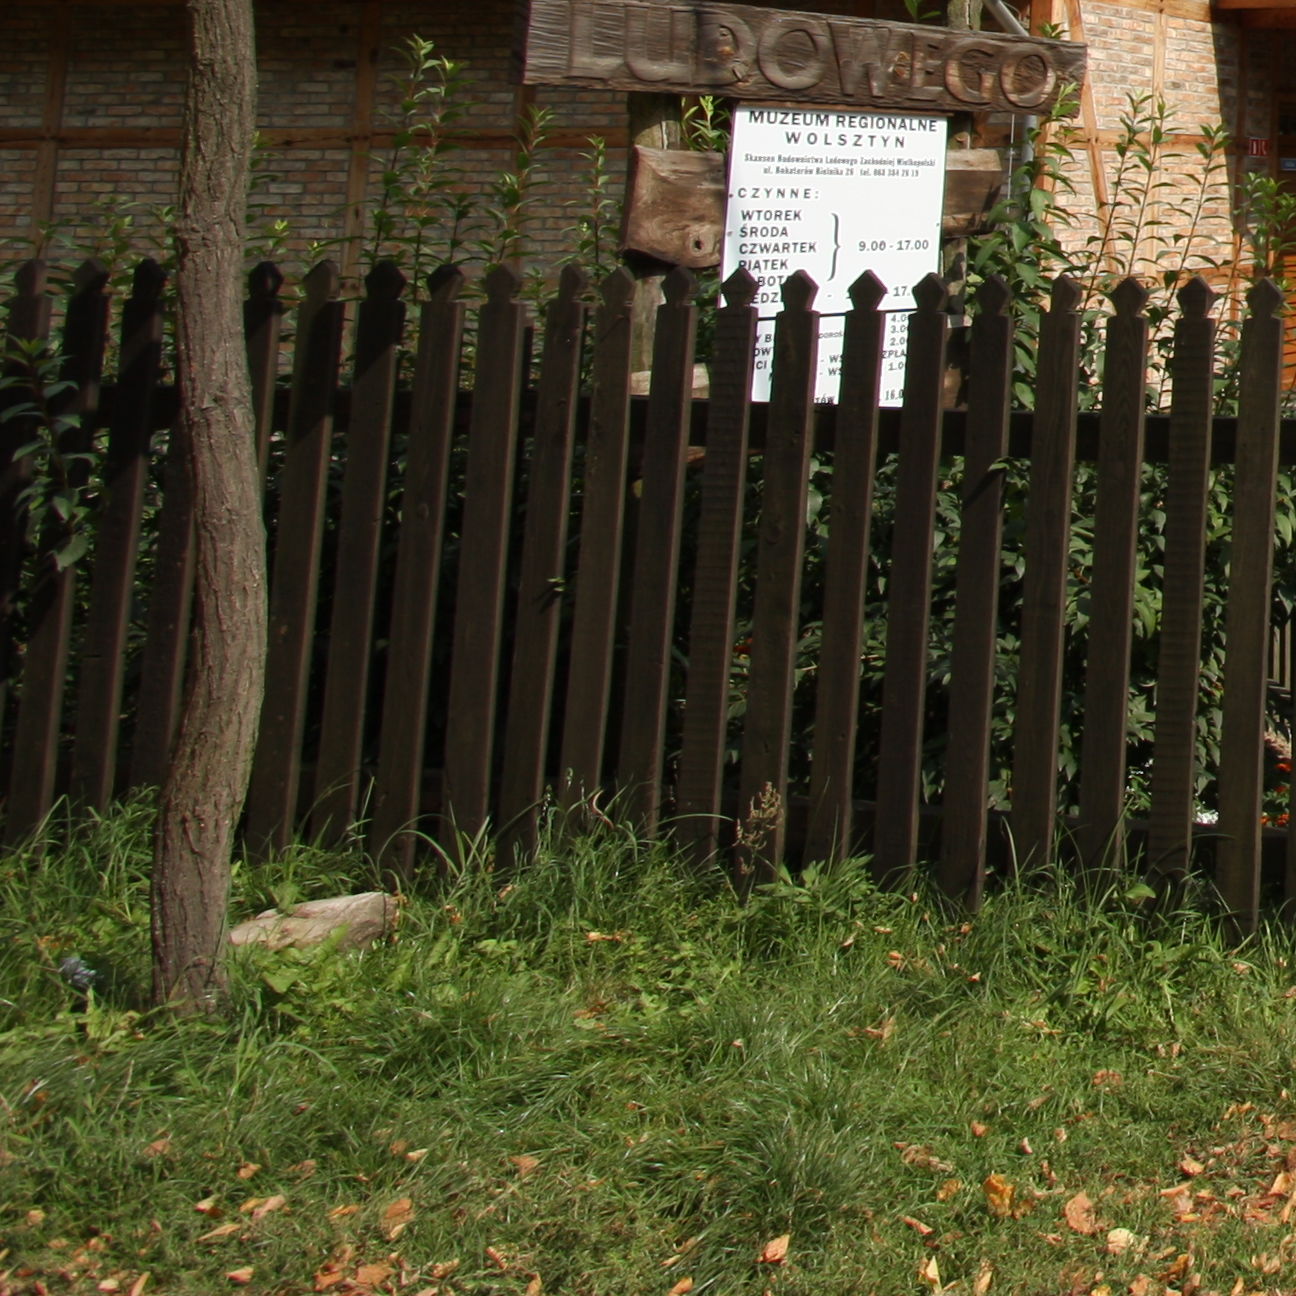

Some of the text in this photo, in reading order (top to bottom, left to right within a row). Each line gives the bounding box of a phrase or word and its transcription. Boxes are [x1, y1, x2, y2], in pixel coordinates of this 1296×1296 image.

[749, 110, 937, 132] MUZEUM REGIONALNE
[786, 131, 905, 148] WOLSZTYN
[738, 188, 820, 200] CZYNNE:
[741, 210, 802, 221] WTOREK
[739, 223, 788, 238] ŚRODA
[739, 242, 816, 254] CZWARTEK
